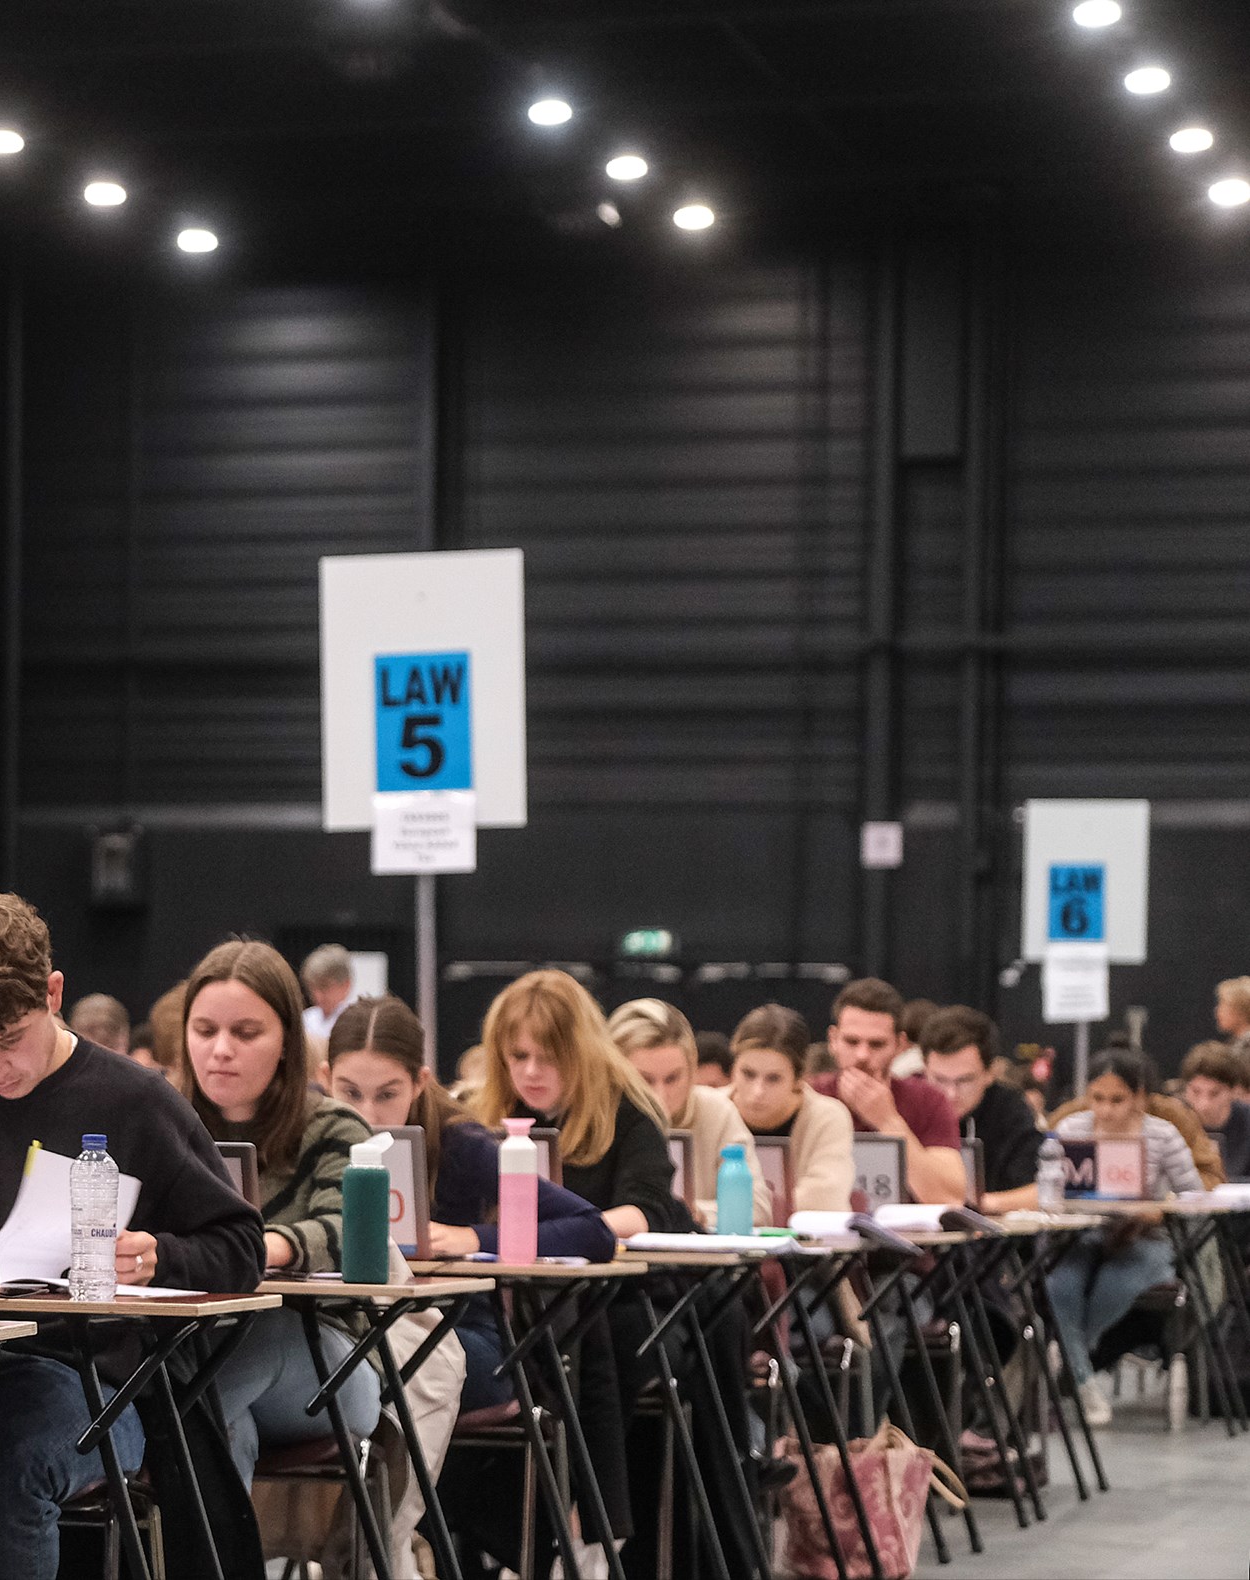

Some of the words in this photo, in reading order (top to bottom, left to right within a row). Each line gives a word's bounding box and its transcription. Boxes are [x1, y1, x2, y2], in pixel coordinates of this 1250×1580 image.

[380, 663, 464, 706] LAW
[400, 715, 445, 778] 5
[1061, 898, 1089, 936] 6
